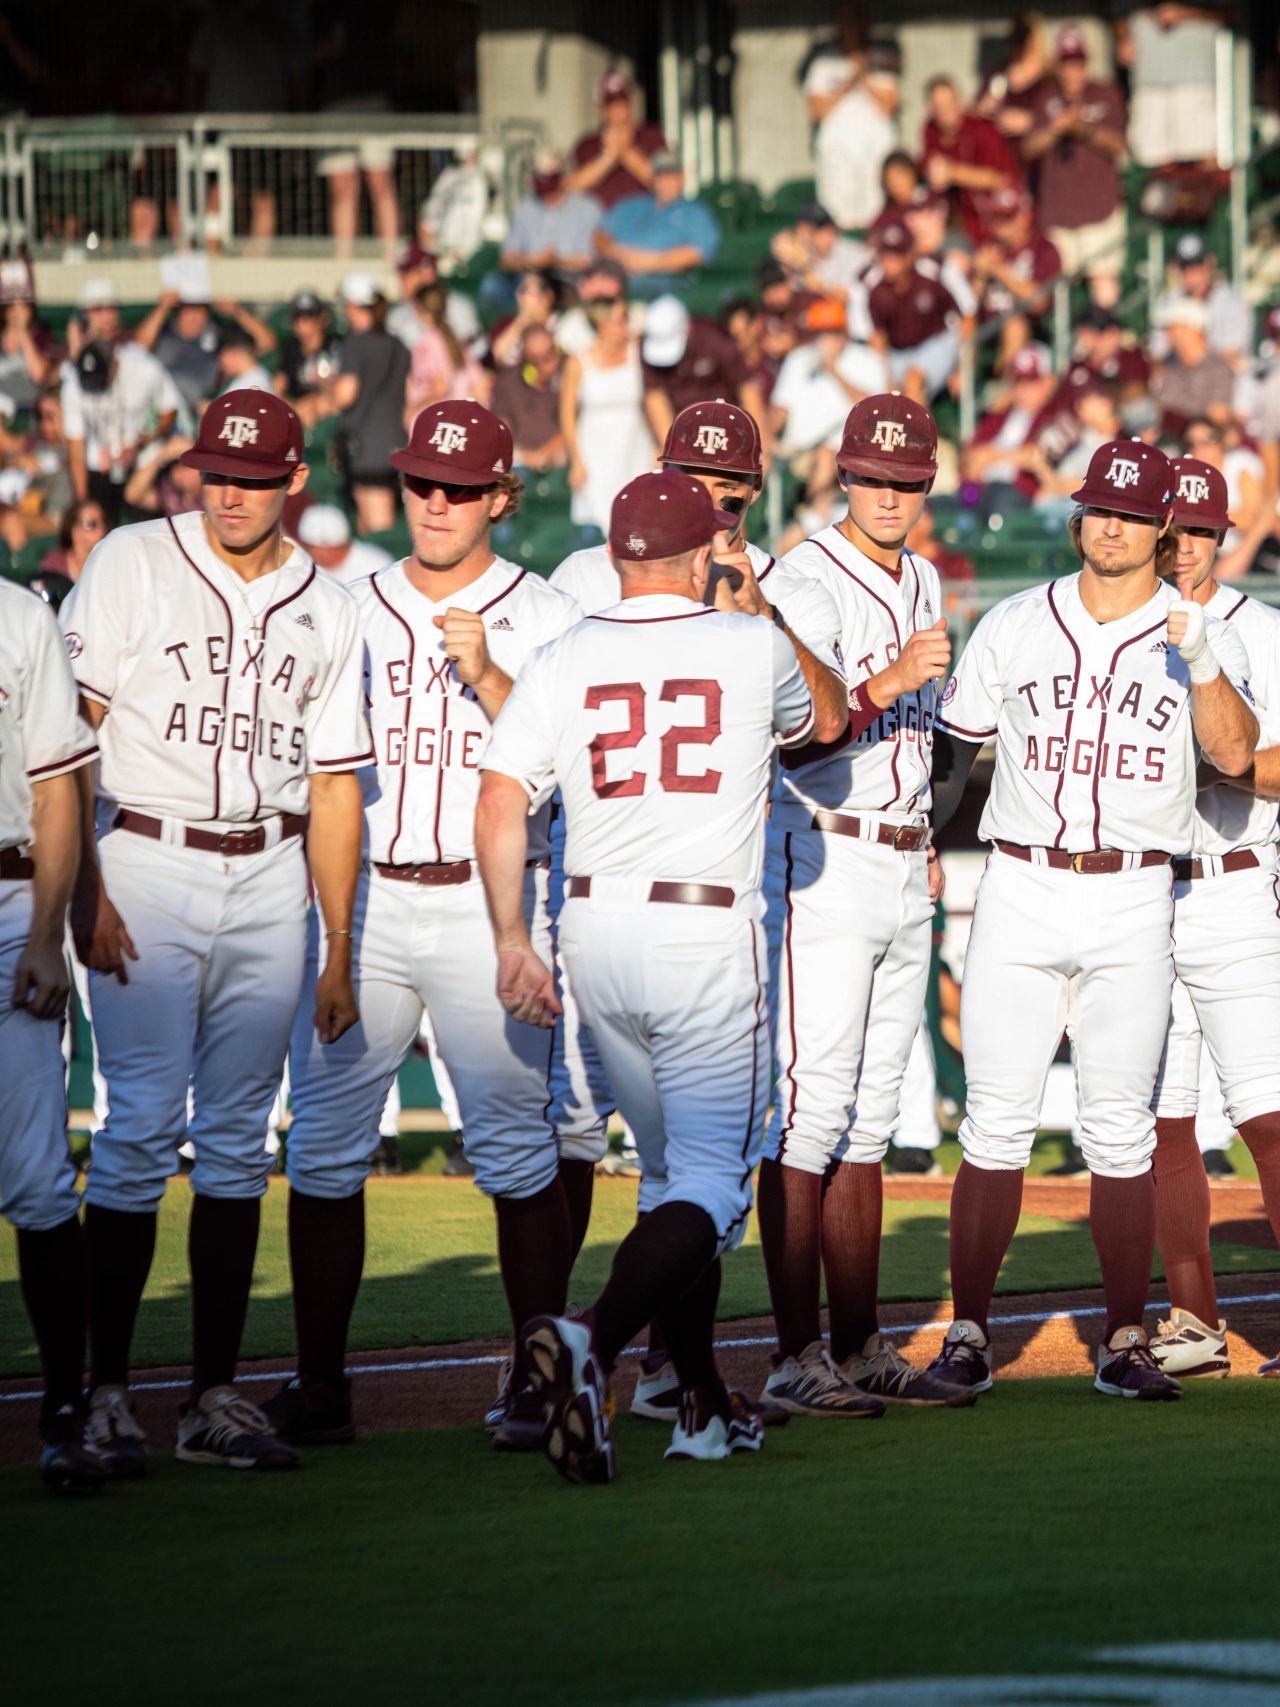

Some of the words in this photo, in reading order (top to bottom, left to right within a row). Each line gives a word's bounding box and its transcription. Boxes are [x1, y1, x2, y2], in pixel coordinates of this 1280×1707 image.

[1018, 674, 1179, 732] TEXAS
[164, 703, 305, 766] AGGIES
[374, 727, 482, 769] GGIE
[583, 678, 724, 800] 22
[1023, 735, 1166, 783] AGGIES
